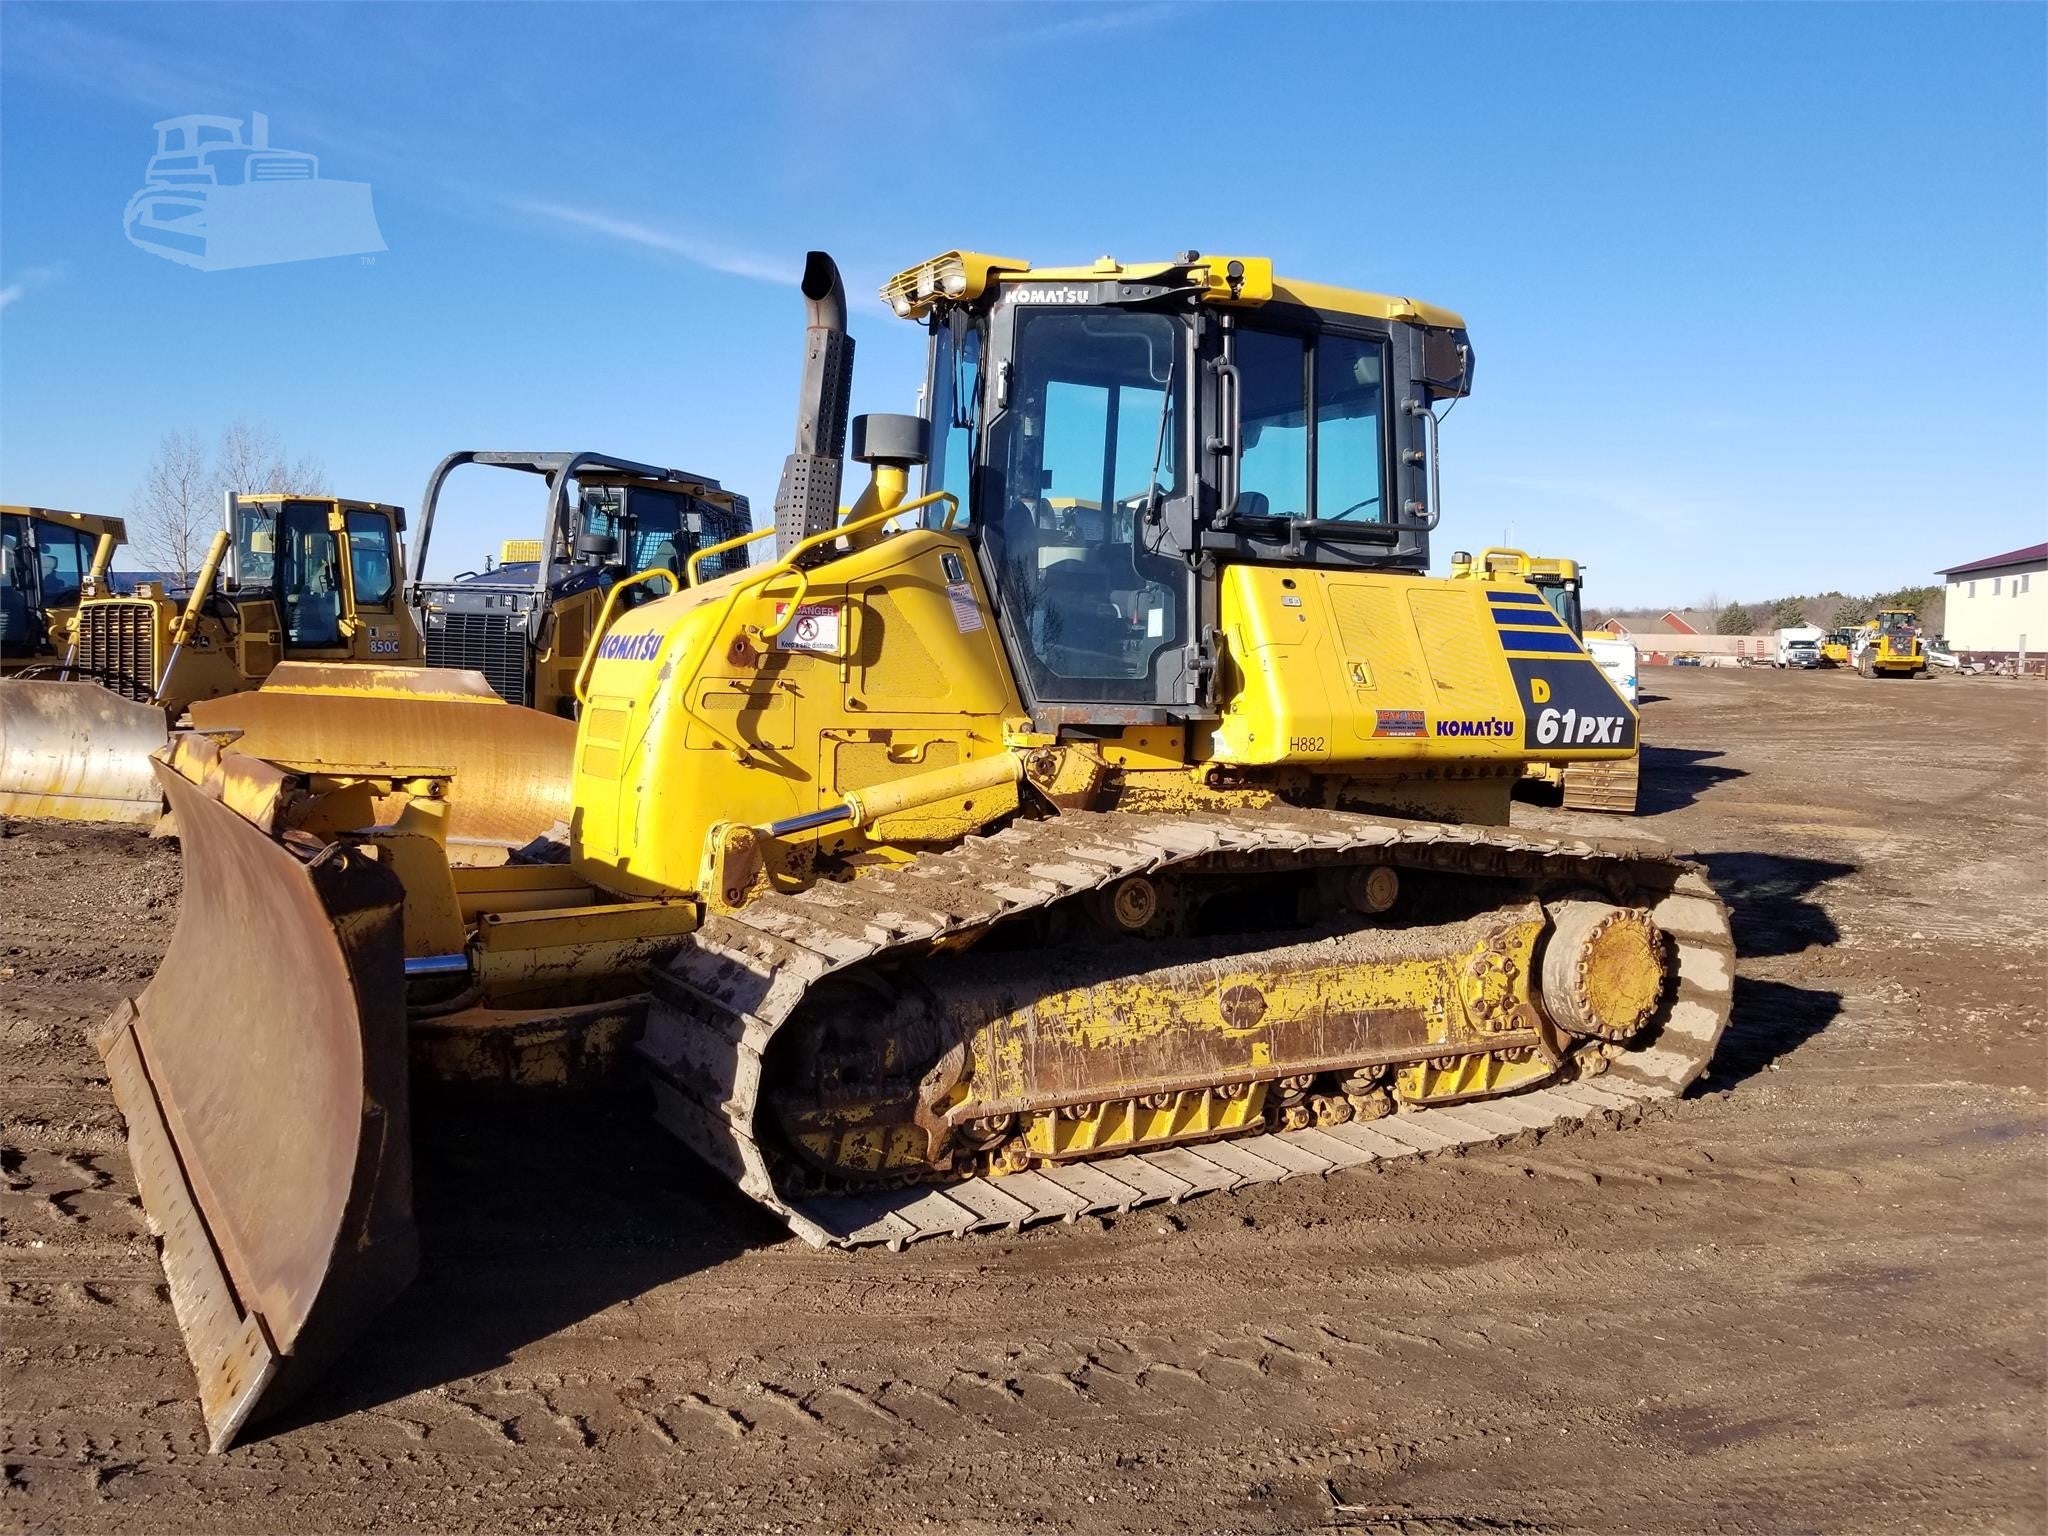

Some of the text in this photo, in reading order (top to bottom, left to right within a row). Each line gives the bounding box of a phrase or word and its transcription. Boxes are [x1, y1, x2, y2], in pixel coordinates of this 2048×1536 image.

[1005, 286, 1089, 304] KOMATSU
[370, 640, 400, 653] 850C
[598, 628, 665, 661] KOMATSU
[781, 640, 795, 649] Keep
[1530, 678, 1551, 704] D
[1437, 717, 1514, 737] KOMATSU
[1290, 736, 1325, 752] H882
